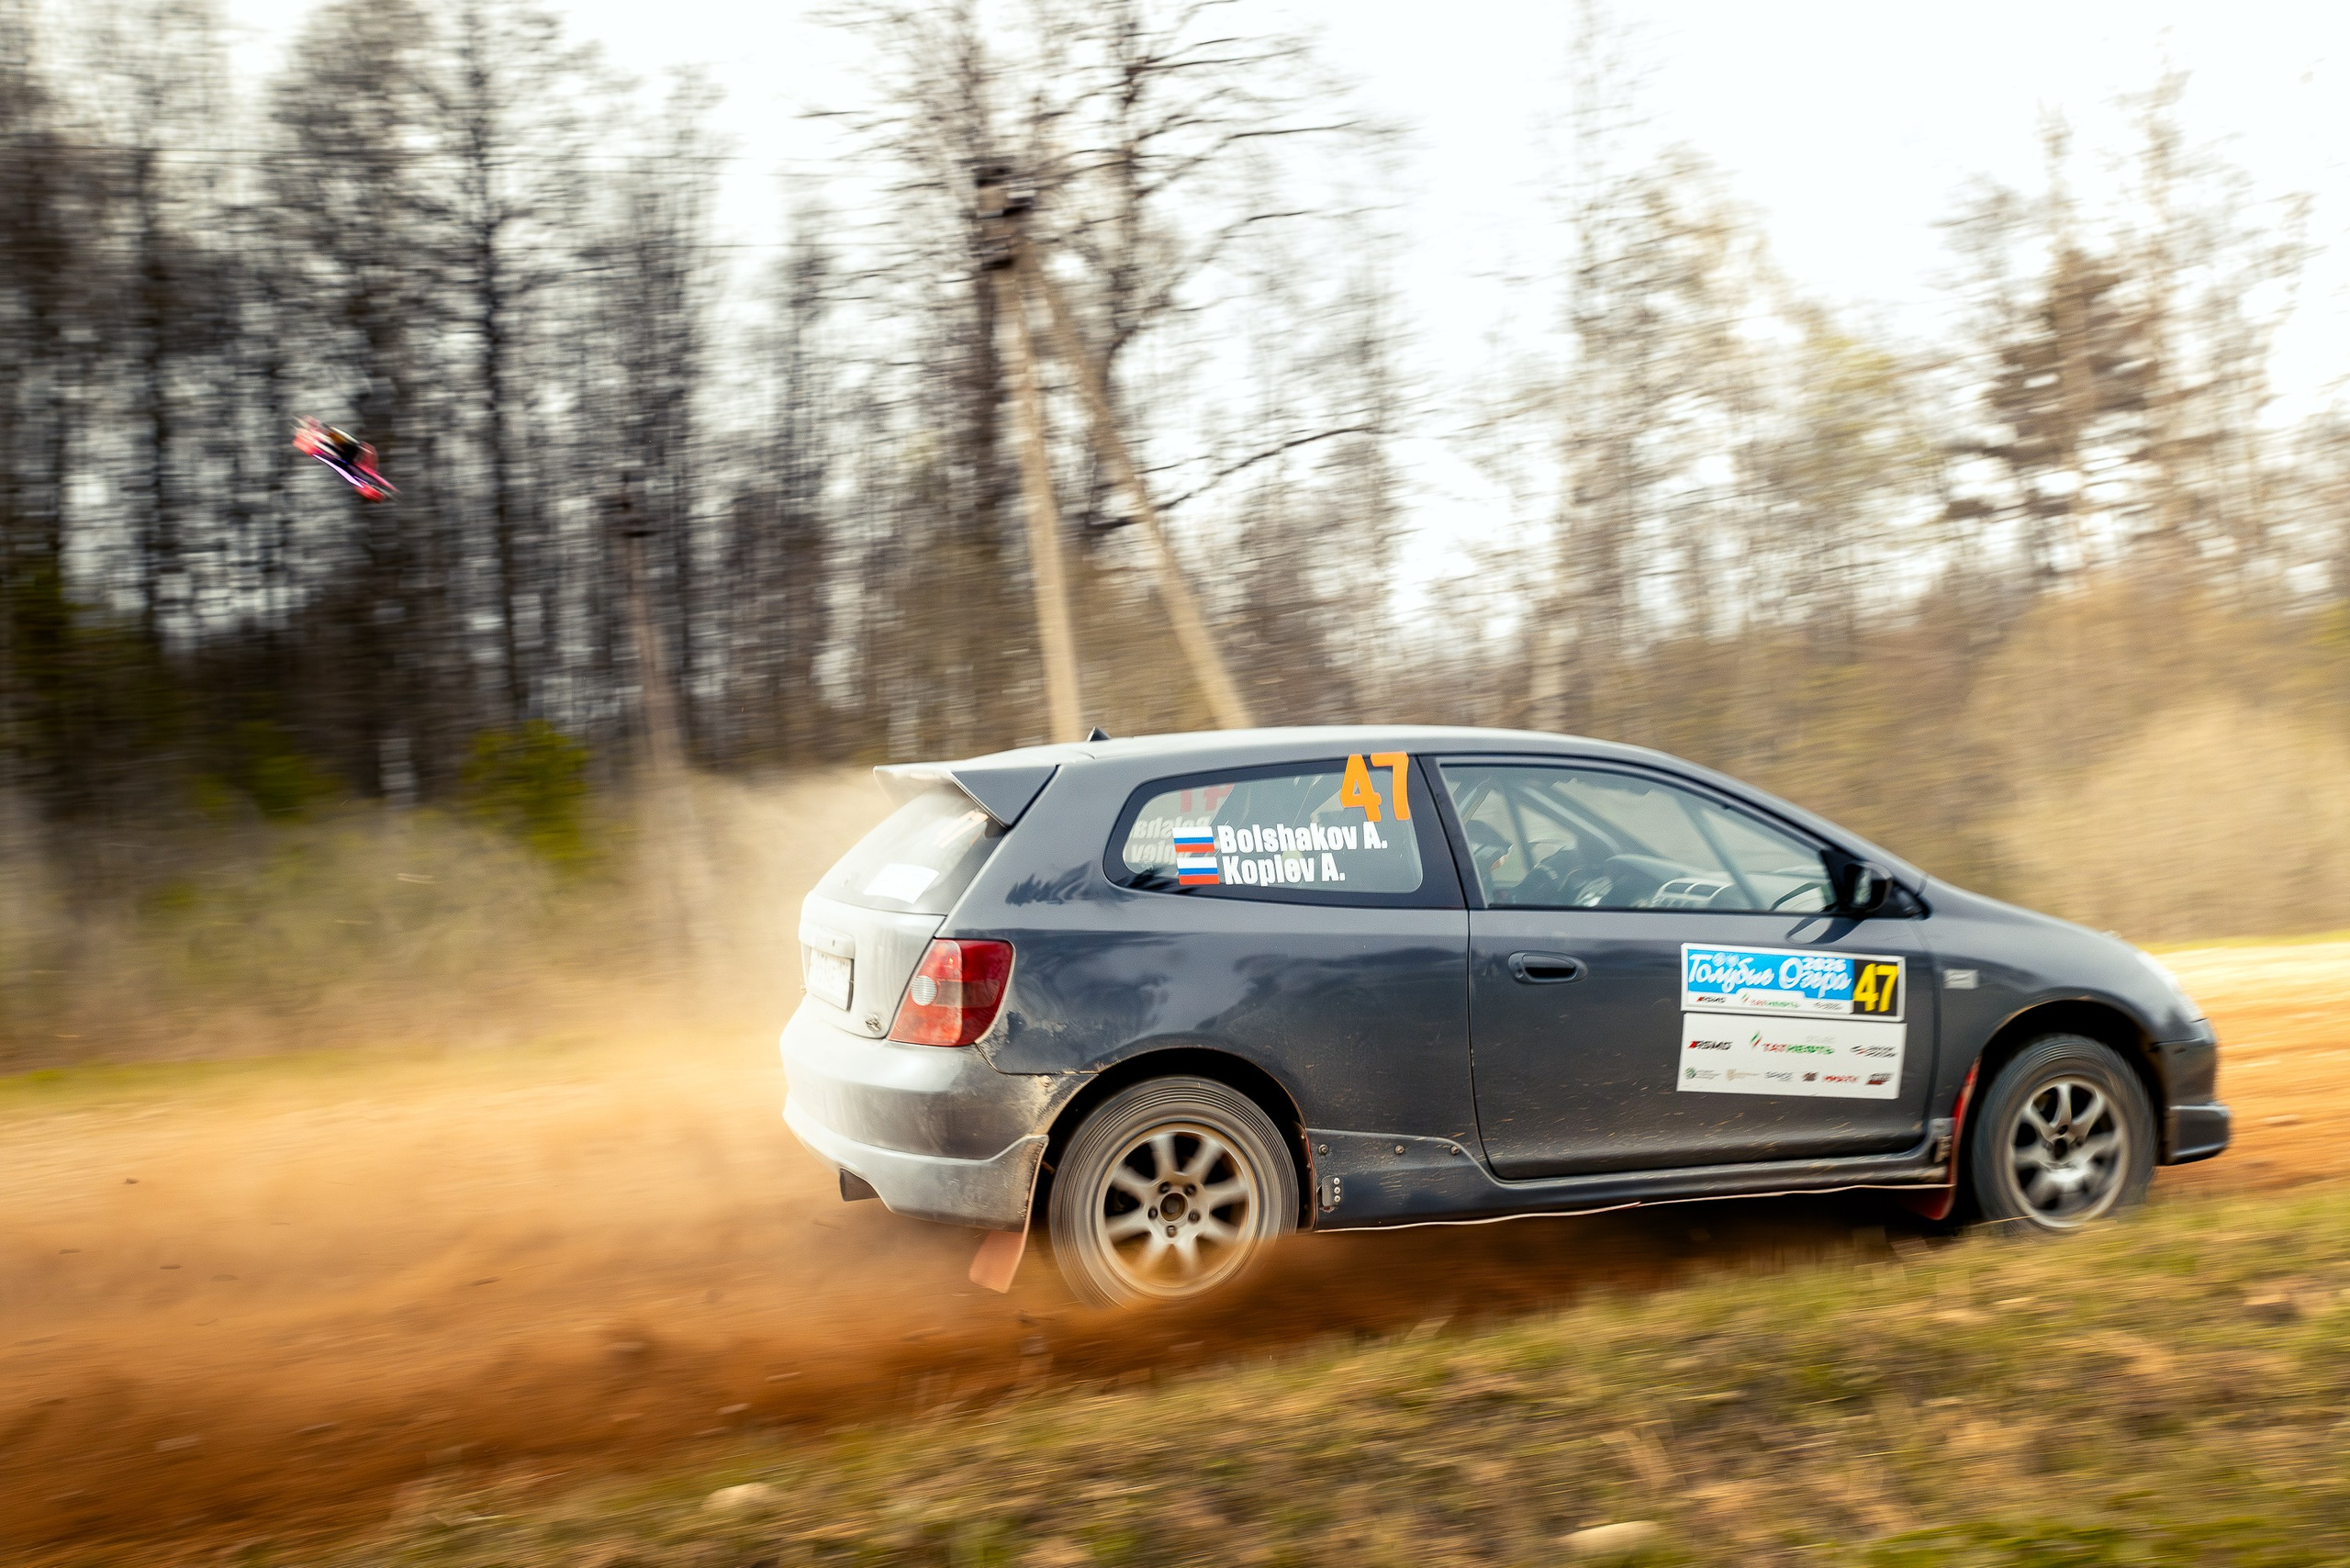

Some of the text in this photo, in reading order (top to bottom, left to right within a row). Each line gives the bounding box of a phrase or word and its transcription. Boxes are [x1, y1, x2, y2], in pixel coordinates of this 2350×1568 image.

[1340, 752, 1411, 822] 47
[1217, 822, 1388, 854] Bolshakov A.
[1222, 852, 1346, 887] Koplev A.
[1852, 963, 1899, 1013] 47
